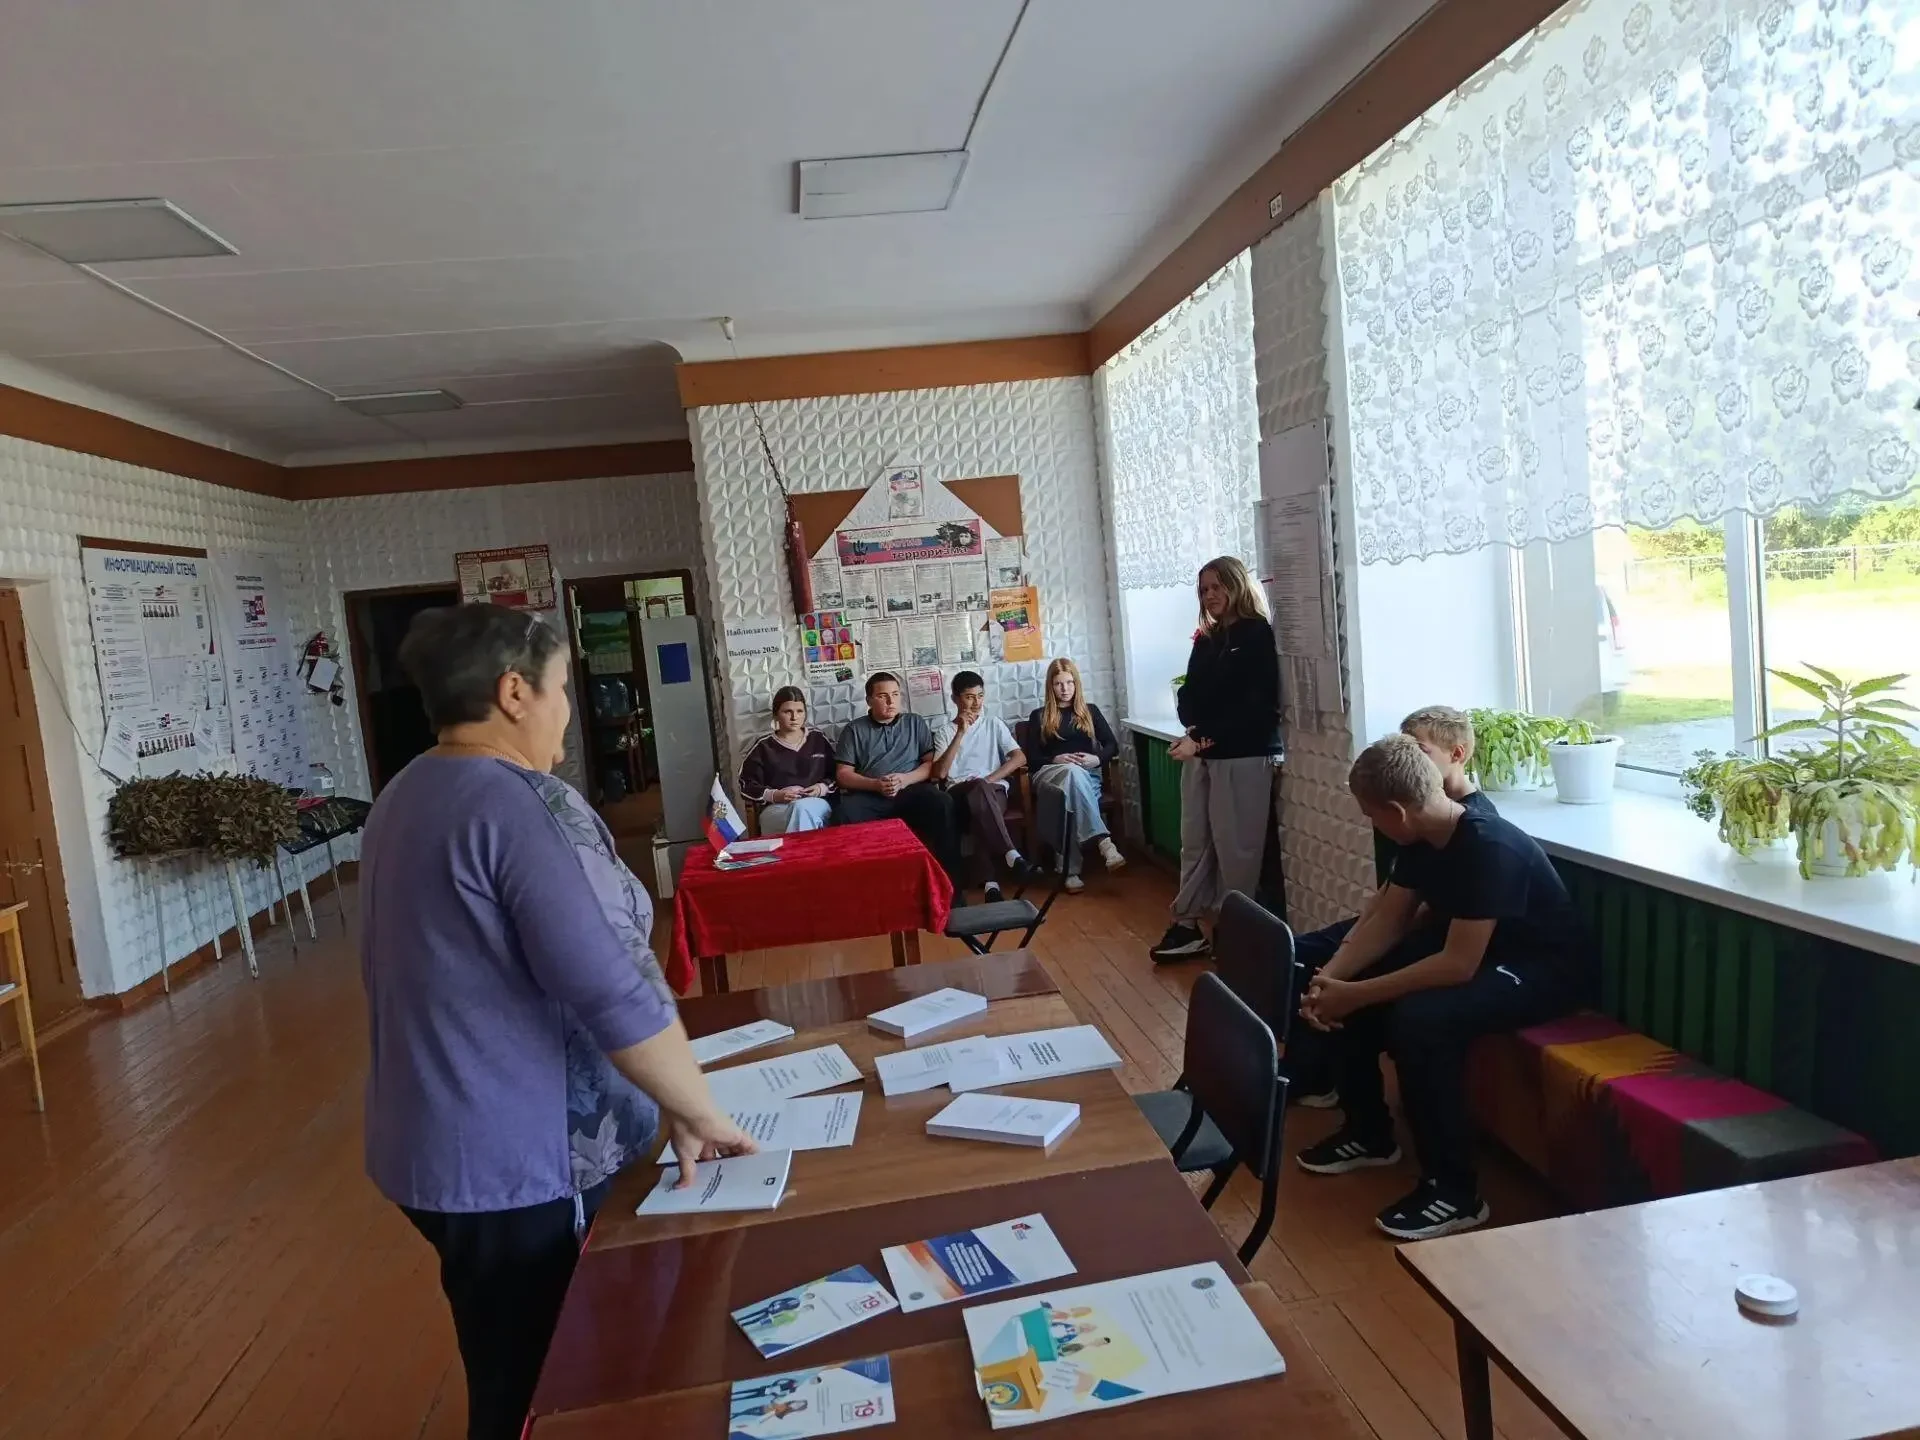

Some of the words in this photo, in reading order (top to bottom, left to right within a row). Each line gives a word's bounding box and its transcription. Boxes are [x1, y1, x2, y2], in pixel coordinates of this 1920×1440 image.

[892, 546, 968, 560] терроризма
[104, 557, 175, 576] ИНФОРМАЦИОННЫЙ
[176, 562, 197, 578] СТЕНД
[729, 649, 761, 657] Выборы
[855, 1399, 875, 1417] 19
